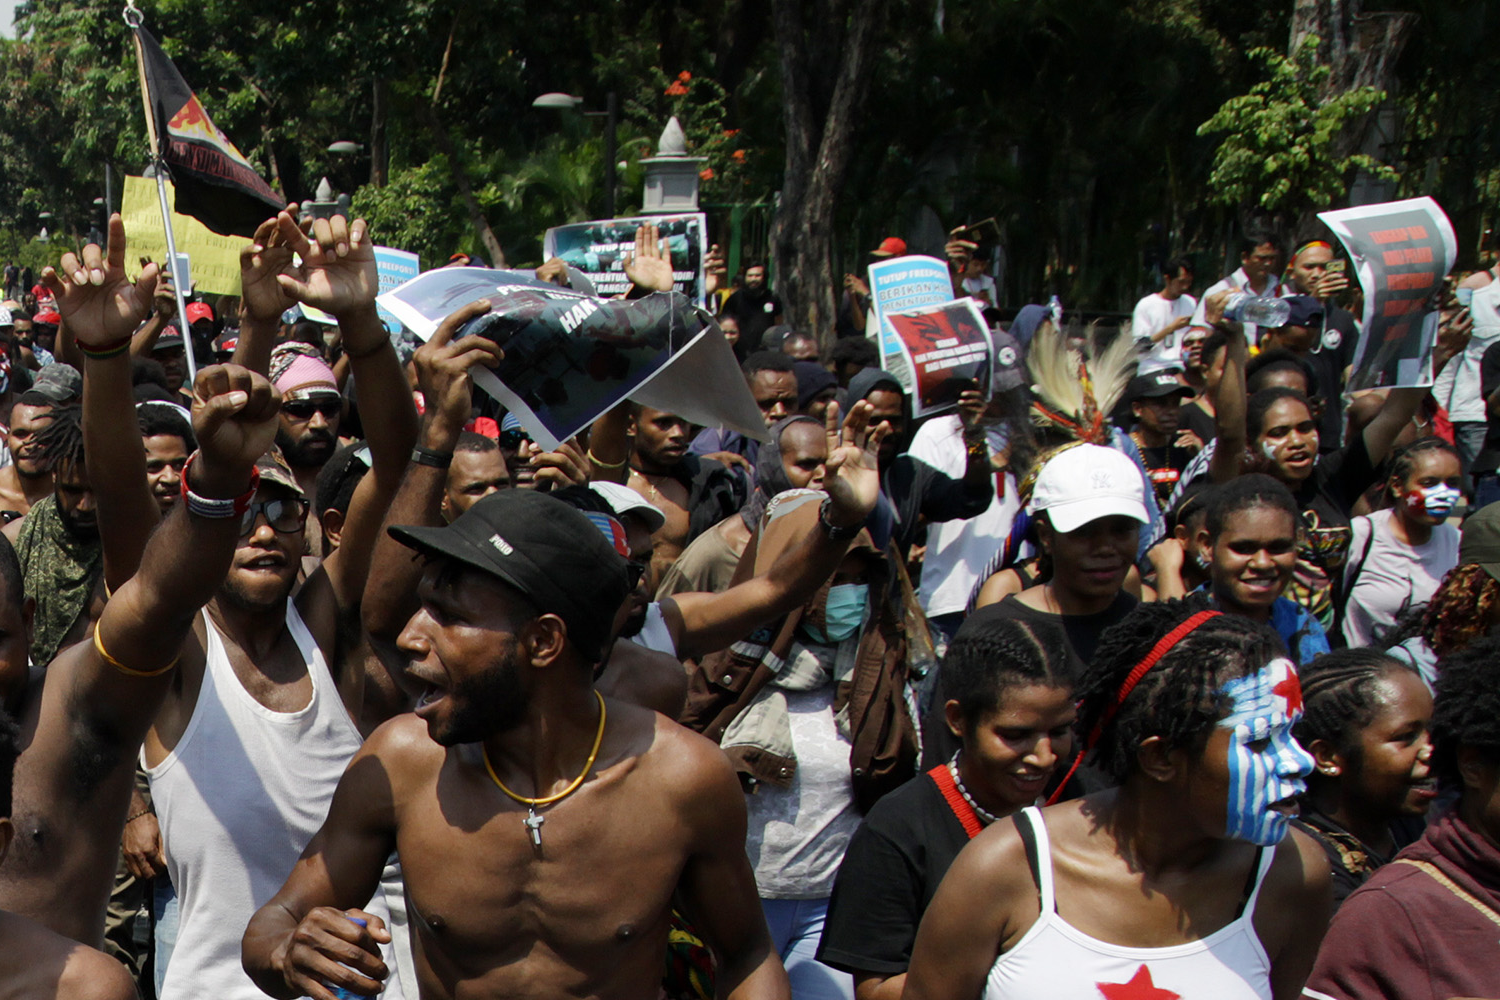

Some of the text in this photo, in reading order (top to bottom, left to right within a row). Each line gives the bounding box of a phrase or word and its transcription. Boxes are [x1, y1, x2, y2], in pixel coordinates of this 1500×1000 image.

[590, 243, 618, 253] TUTUP
[878, 271, 908, 286] TUTUP
[879, 282, 932, 302] BERIKAN
[559, 299, 598, 334] HAK
